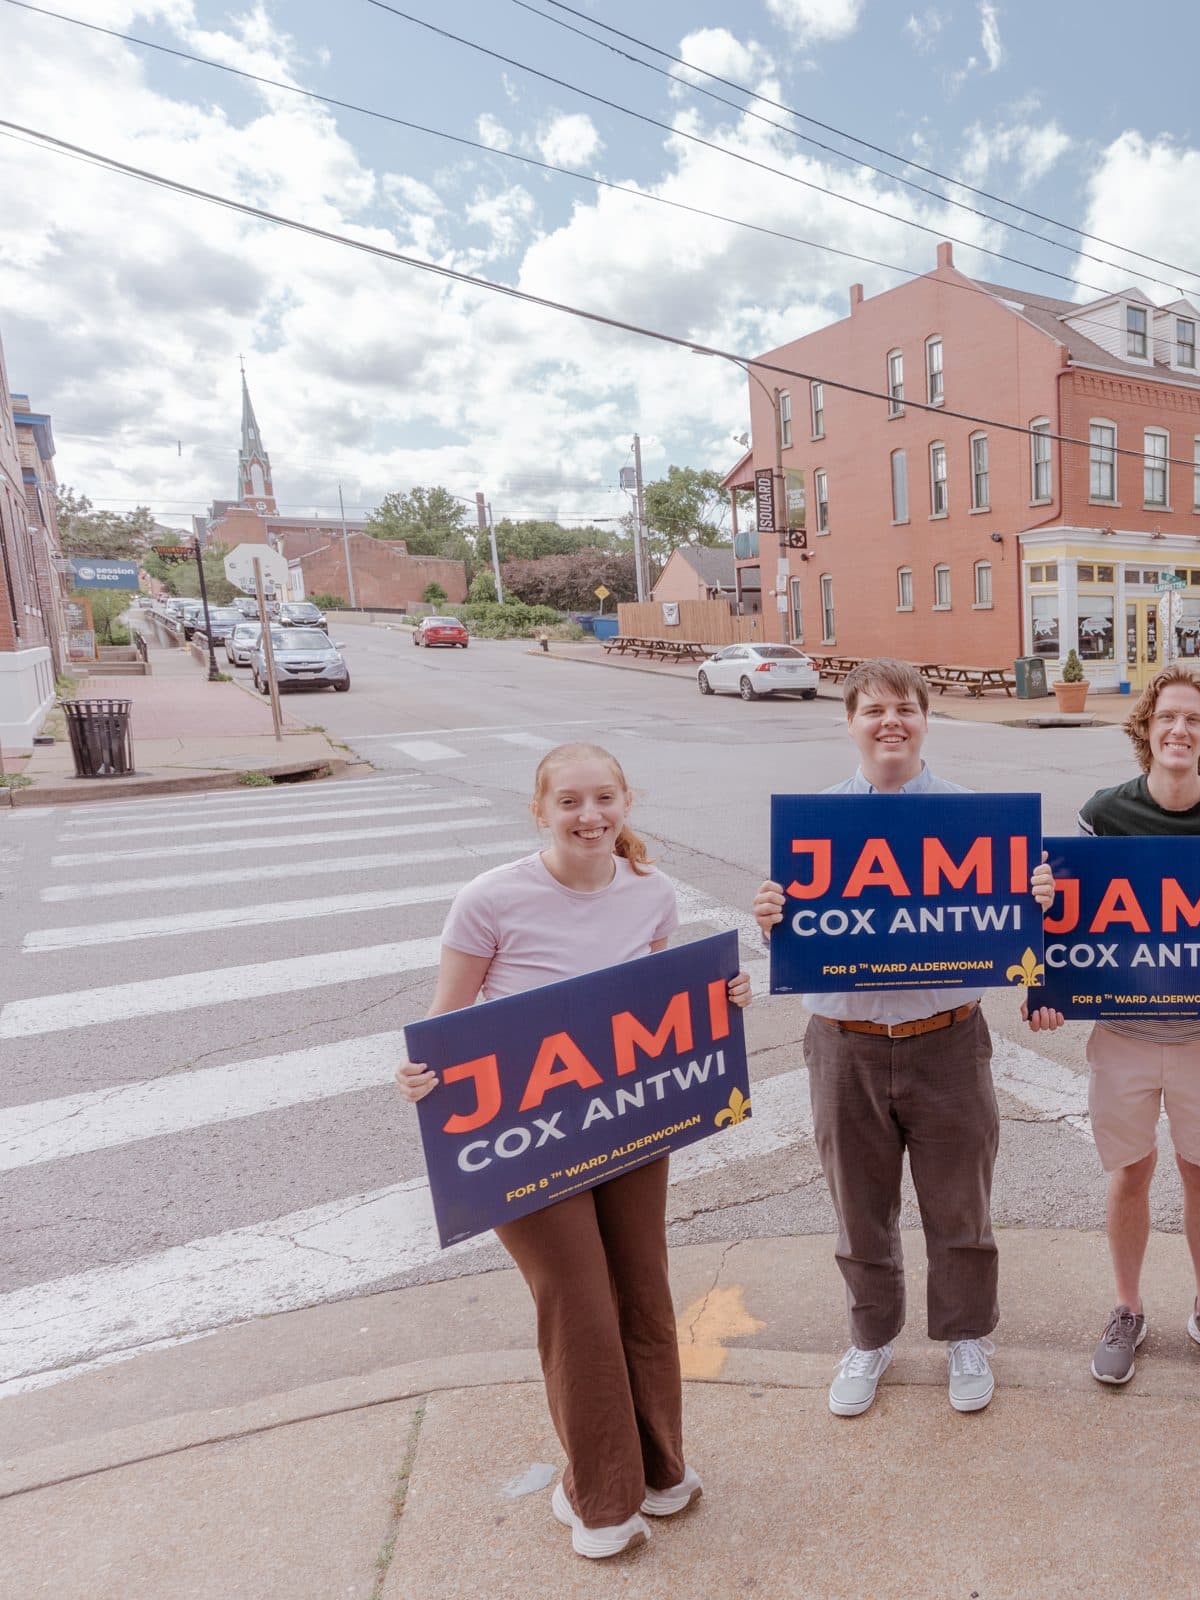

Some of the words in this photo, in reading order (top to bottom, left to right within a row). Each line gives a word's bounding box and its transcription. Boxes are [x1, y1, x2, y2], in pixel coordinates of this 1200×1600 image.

[759, 477, 773, 528] SOULARD
[96, 567, 134, 575] session
[785, 836, 1028, 900] JAMI
[792, 908, 876, 936] COX
[888, 905, 1021, 934] ANTWI
[822, 965, 846, 975] FOR
[849, 965, 857, 974] 8
[871, 963, 907, 973] WARD
[909, 960, 993, 972] ALDERWOMAN
[1045, 943, 1119, 968] COX
[1072, 995, 1093, 1004] FOR
[1095, 995, 1102, 1004] 8
[1115, 995, 1147, 1003] WARD
[442, 978, 730, 1134] JAMI
[457, 1111, 567, 1173] COX
[581, 1050, 726, 1130] ANTWI
[506, 1183, 536, 1202] FOR
[539, 1178, 549, 1189] 8
[550, 1170, 562, 1180] TH
[564, 1154, 608, 1178] WARD
[611, 1114, 701, 1160] ALDERWOMAN
